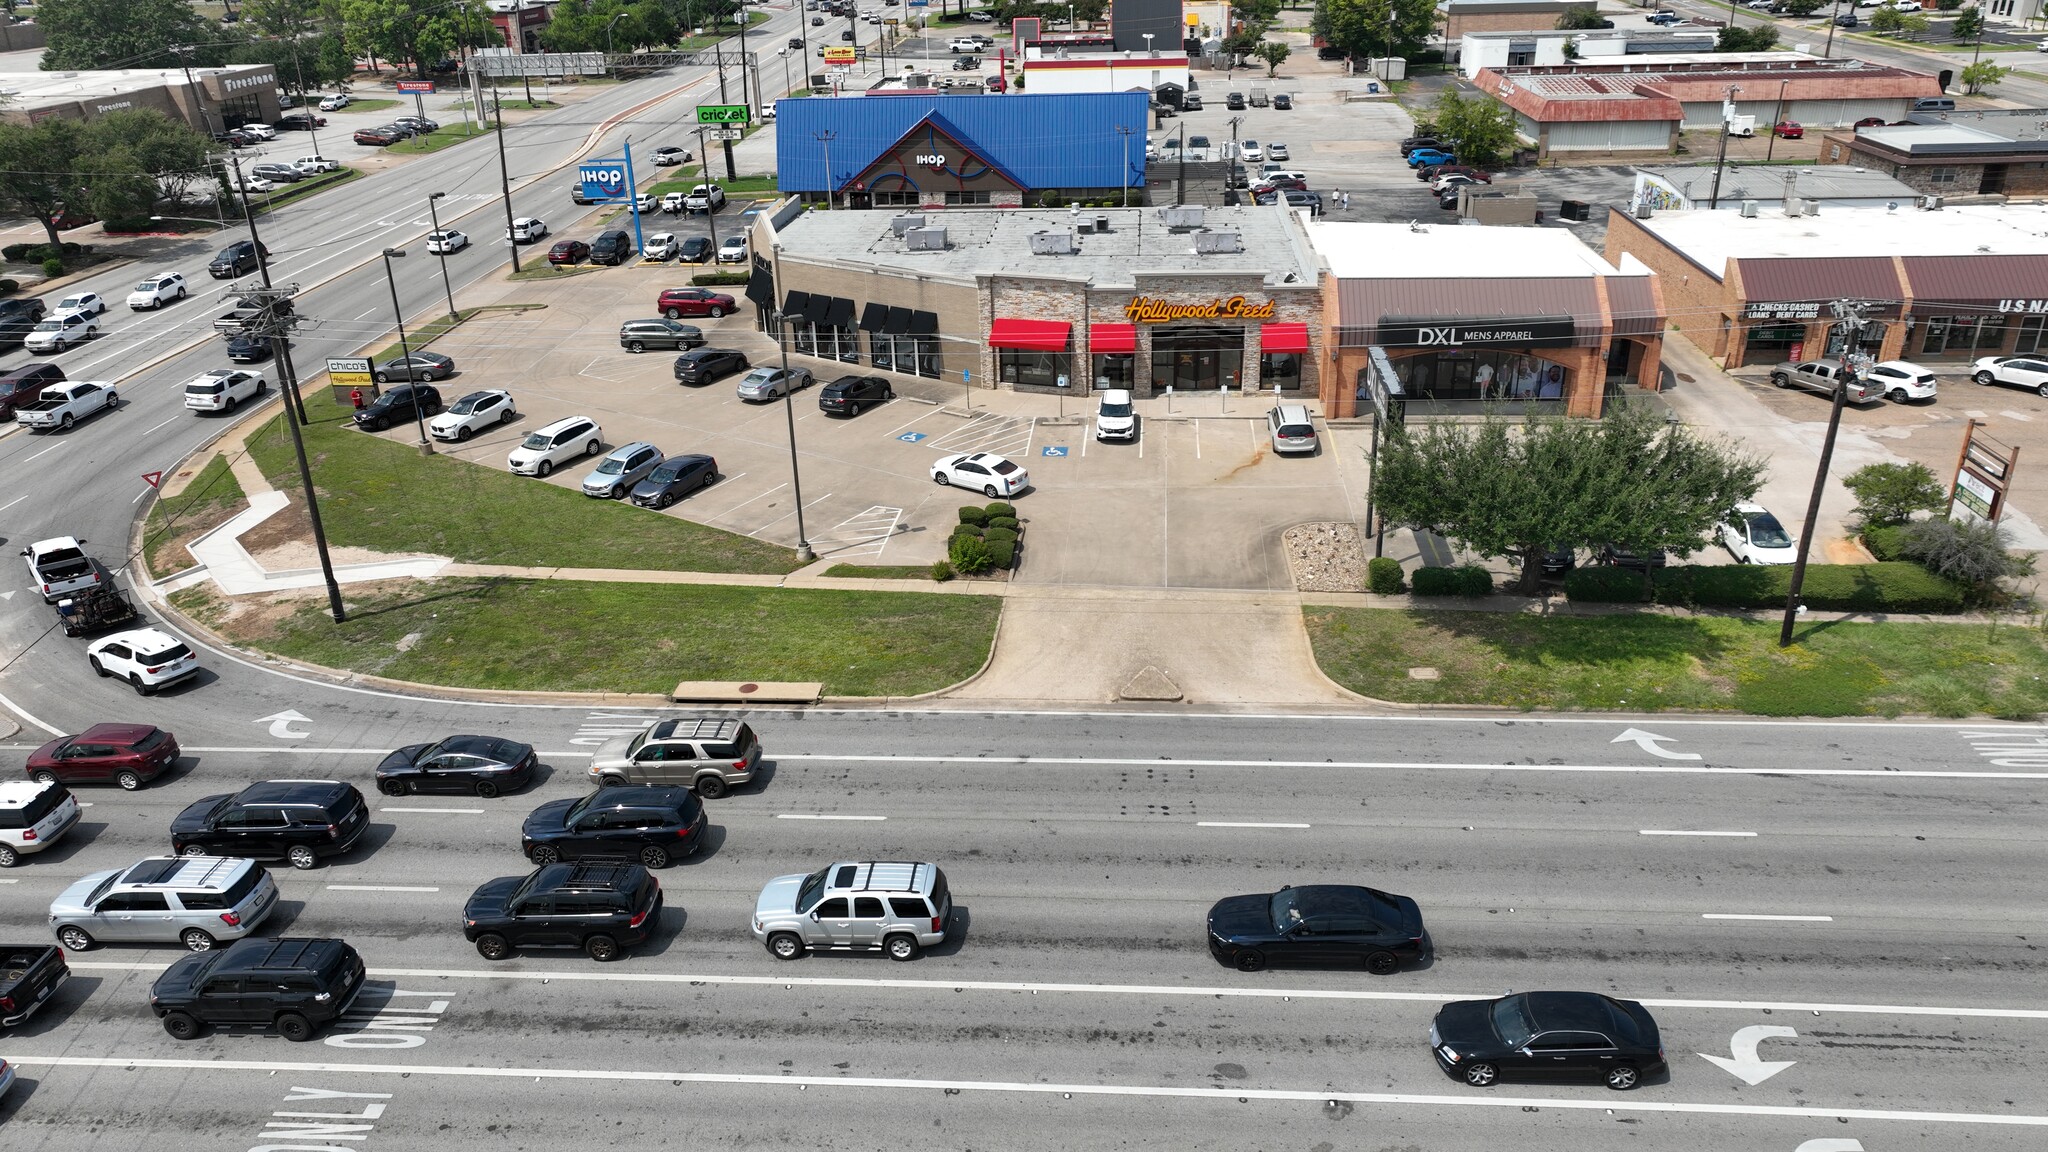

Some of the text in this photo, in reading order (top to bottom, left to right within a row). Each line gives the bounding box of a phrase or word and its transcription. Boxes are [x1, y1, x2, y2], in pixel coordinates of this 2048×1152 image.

[224, 72, 274, 92] Firestone
[97, 100, 131, 114] Firestone
[701, 108, 745, 121] cricket
[917, 155, 945, 167] IHOP
[580, 170, 622, 187] IHOP
[1124, 296, 1275, 323] Hollywood Feed
[1758, 303, 1820, 311] CHECKS CASHED
[1418, 328, 1533, 346] DXL MENS APPAREL
[330, 362, 367, 370] chico's
